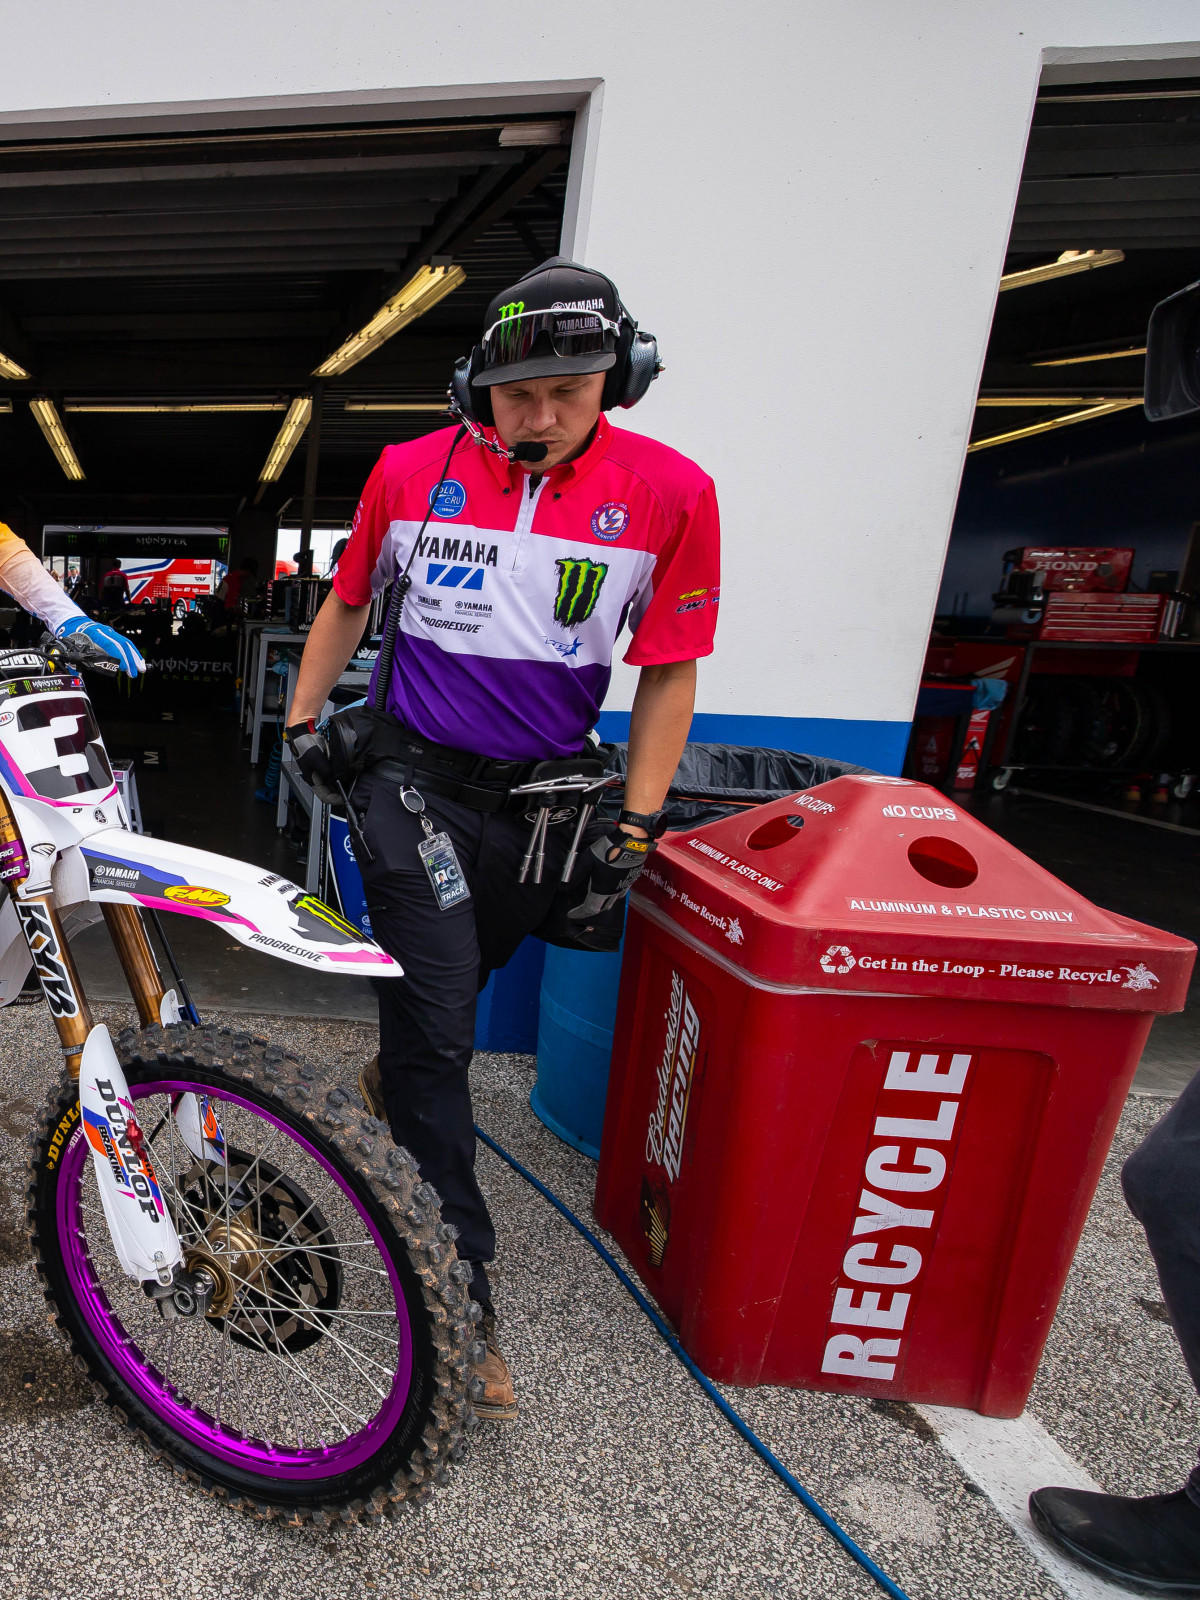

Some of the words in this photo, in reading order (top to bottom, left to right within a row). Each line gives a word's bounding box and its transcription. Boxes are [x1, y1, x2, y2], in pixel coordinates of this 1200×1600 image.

[564, 298, 605, 311] YAMAHA
[556, 316, 600, 332] YAMALUBE
[445, 496, 461, 505] CRU
[416, 536, 498, 567] YAMAHA
[1034, 561, 1098, 572] HOND
[417, 595, 442, 607] YAMALUBE
[463, 601, 493, 612] YAMAHA
[420, 615, 481, 634] PROGRESSIVE
[16, 696, 115, 800] 3
[793, 794, 810, 807] NO
[808, 798, 836, 815] CUPS
[882, 805, 907, 817] NO
[910, 806, 957, 820] CUPS
[105, 866, 140, 880] YAMAHA
[687, 838, 725, 862] ALUMINUM
[720, 856, 731, 864] &
[726, 859, 760, 881] PLASTIC
[757, 876, 784, 892] ONLY
[93, 877, 115, 886] FINANCIAL
[115, 880, 137, 889] SERVICES
[164, 886, 230, 903] FMF
[442, 886, 465, 901] TRACK
[663, 880, 677, 899] Loop
[680, 892, 700, 913] Please
[699, 906, 727, 930] Recycle
[850, 899, 937, 915] ALUMINUM
[941, 904, 953, 915] &
[956, 905, 1027, 920] PLASTIC
[1030, 910, 1073, 923] ONLY
[249, 933, 325, 963] PROGRESSIVE
[858, 956, 887, 970] Get
[890, 957, 907, 971] in
[911, 959, 938, 973] the
[943, 961, 985, 978] Loop
[999, 965, 1054, 980] Please
[1057, 967, 1122, 985] Recycle
[645, 970, 683, 1166] Budweiser
[95, 1077, 160, 1224] DUNLOP
[98, 1125, 125, 1184] BRAKING
[821, 1051, 972, 1380] RECYCLE
